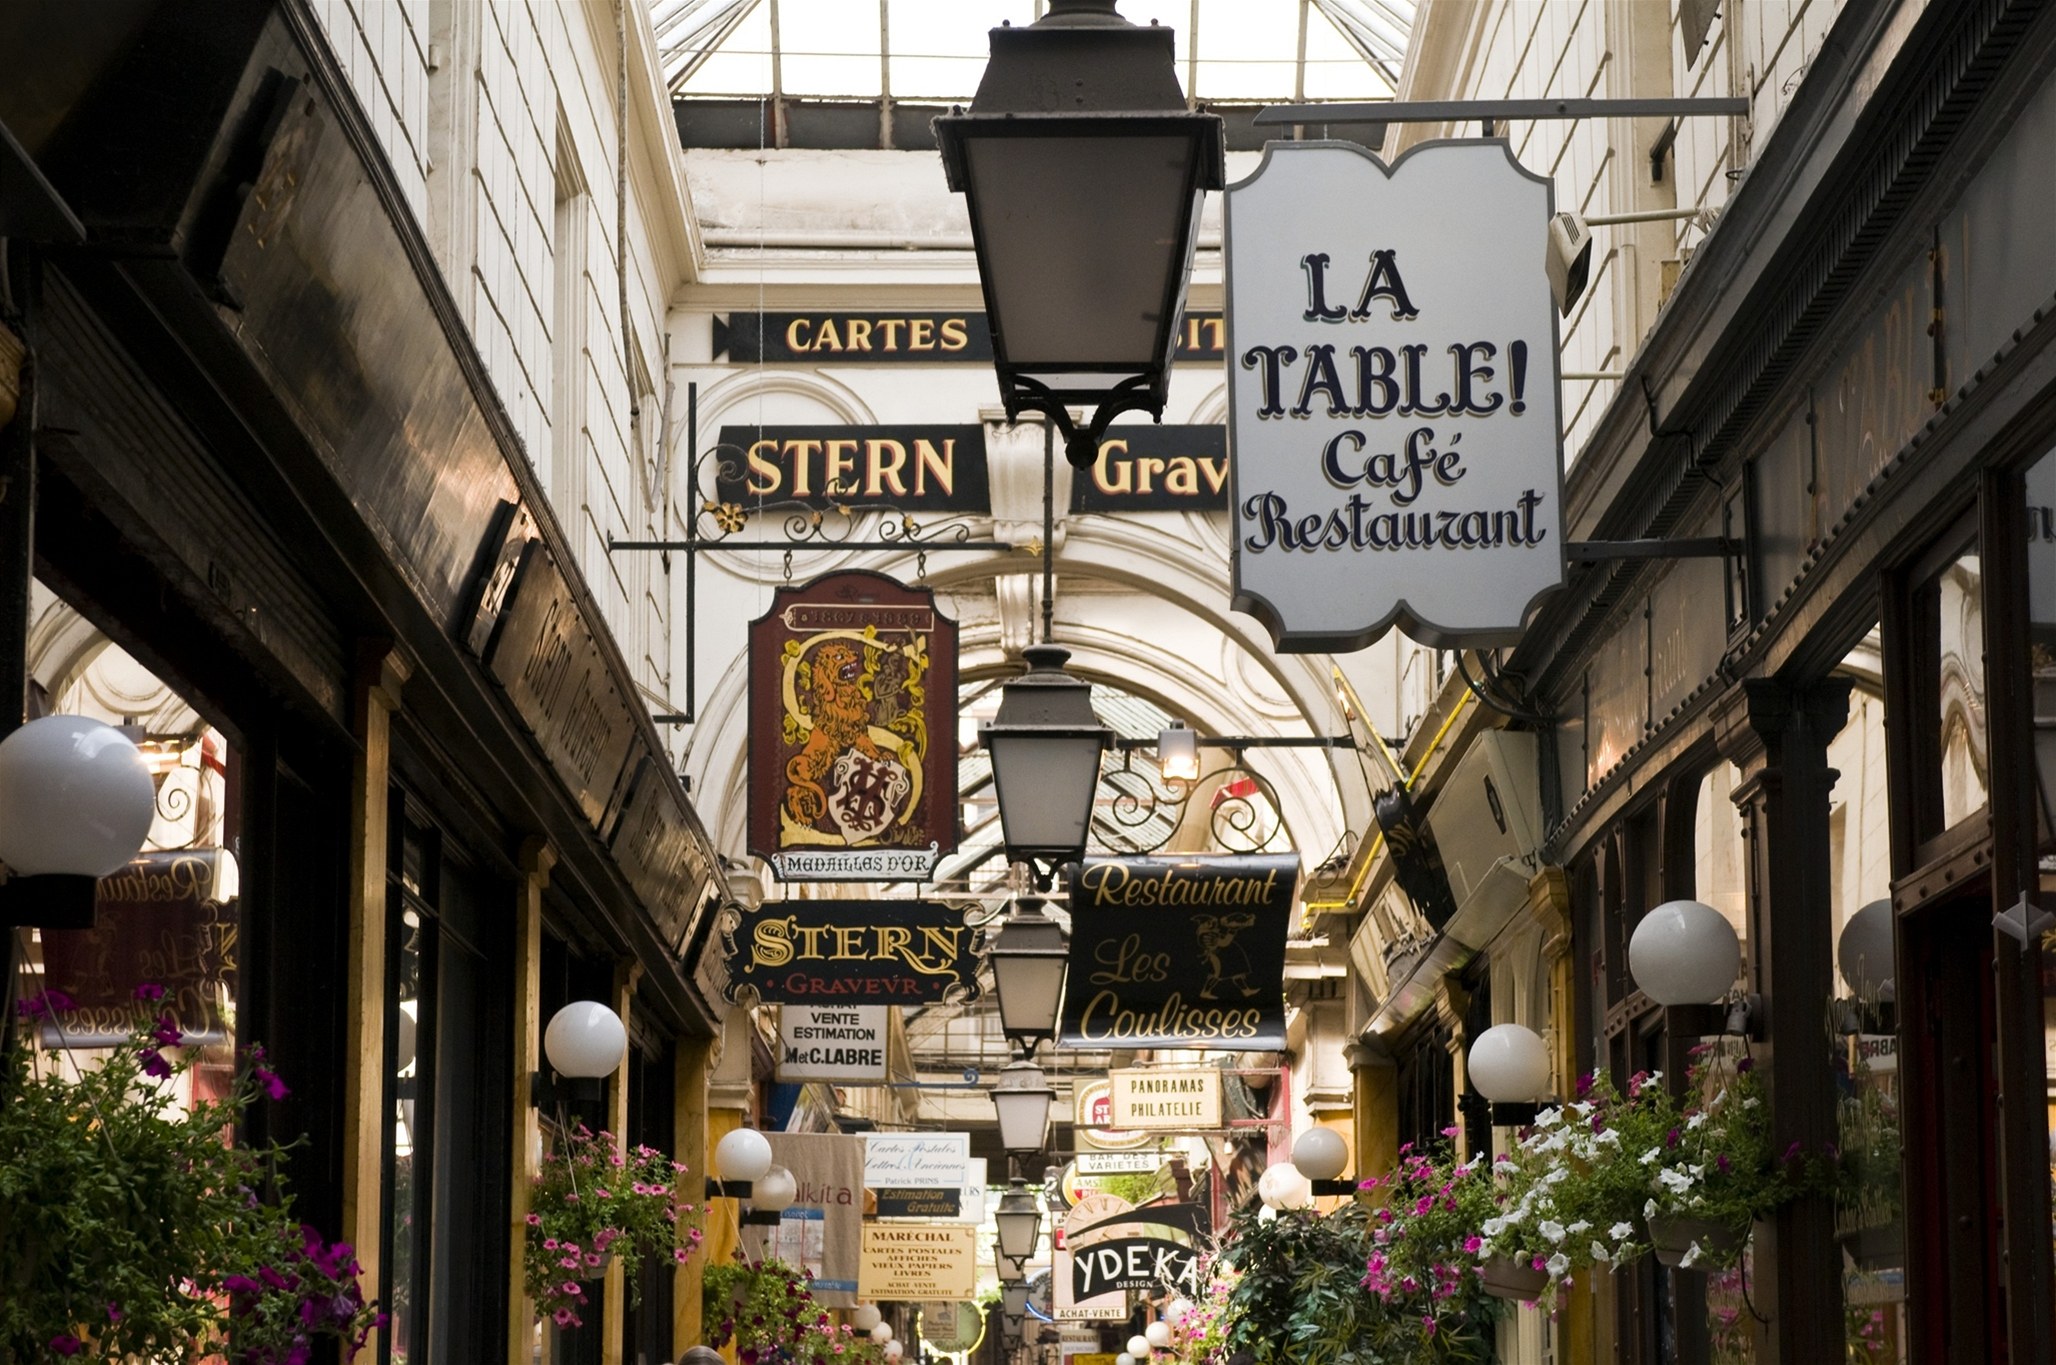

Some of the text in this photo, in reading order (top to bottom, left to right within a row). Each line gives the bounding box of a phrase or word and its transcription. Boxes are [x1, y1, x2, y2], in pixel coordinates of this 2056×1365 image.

[1301, 248, 1420, 323] LA
[786, 318, 968, 353] CARTES
[1242, 339, 1528, 421] TABLE!
[746, 438, 1229, 498] STERN Grav
[1322, 427, 1467, 504] Café
[1242, 489, 1546, 552] Restaurant
[1082, 862, 1277, 906] Restaurant
[744, 915, 965, 982] STERN
[1089, 933, 1171, 985] Les
[811, 1012, 860, 1026] VENTE
[1081, 990, 1261, 1041] Coulisses
[794, 1026, 876, 1041] ESTIMATION
[1131, 1078, 1204, 1094] PANORAMAS
[1131, 1101, 1203, 1117] PHILATELIE
[885, 1176, 940, 1185] Patrick PRINS
[1089, 1160, 1150, 1171] VARIETES
[882, 1189, 945, 1201] Estimation
[907, 1201, 956, 1214] Gratuite
[1074, 1246, 1198, 1296] YDEKA
[1116, 1280, 1153, 1289] DESIGN
[1060, 1308, 1121, 1318] ACHAT-VENTE
